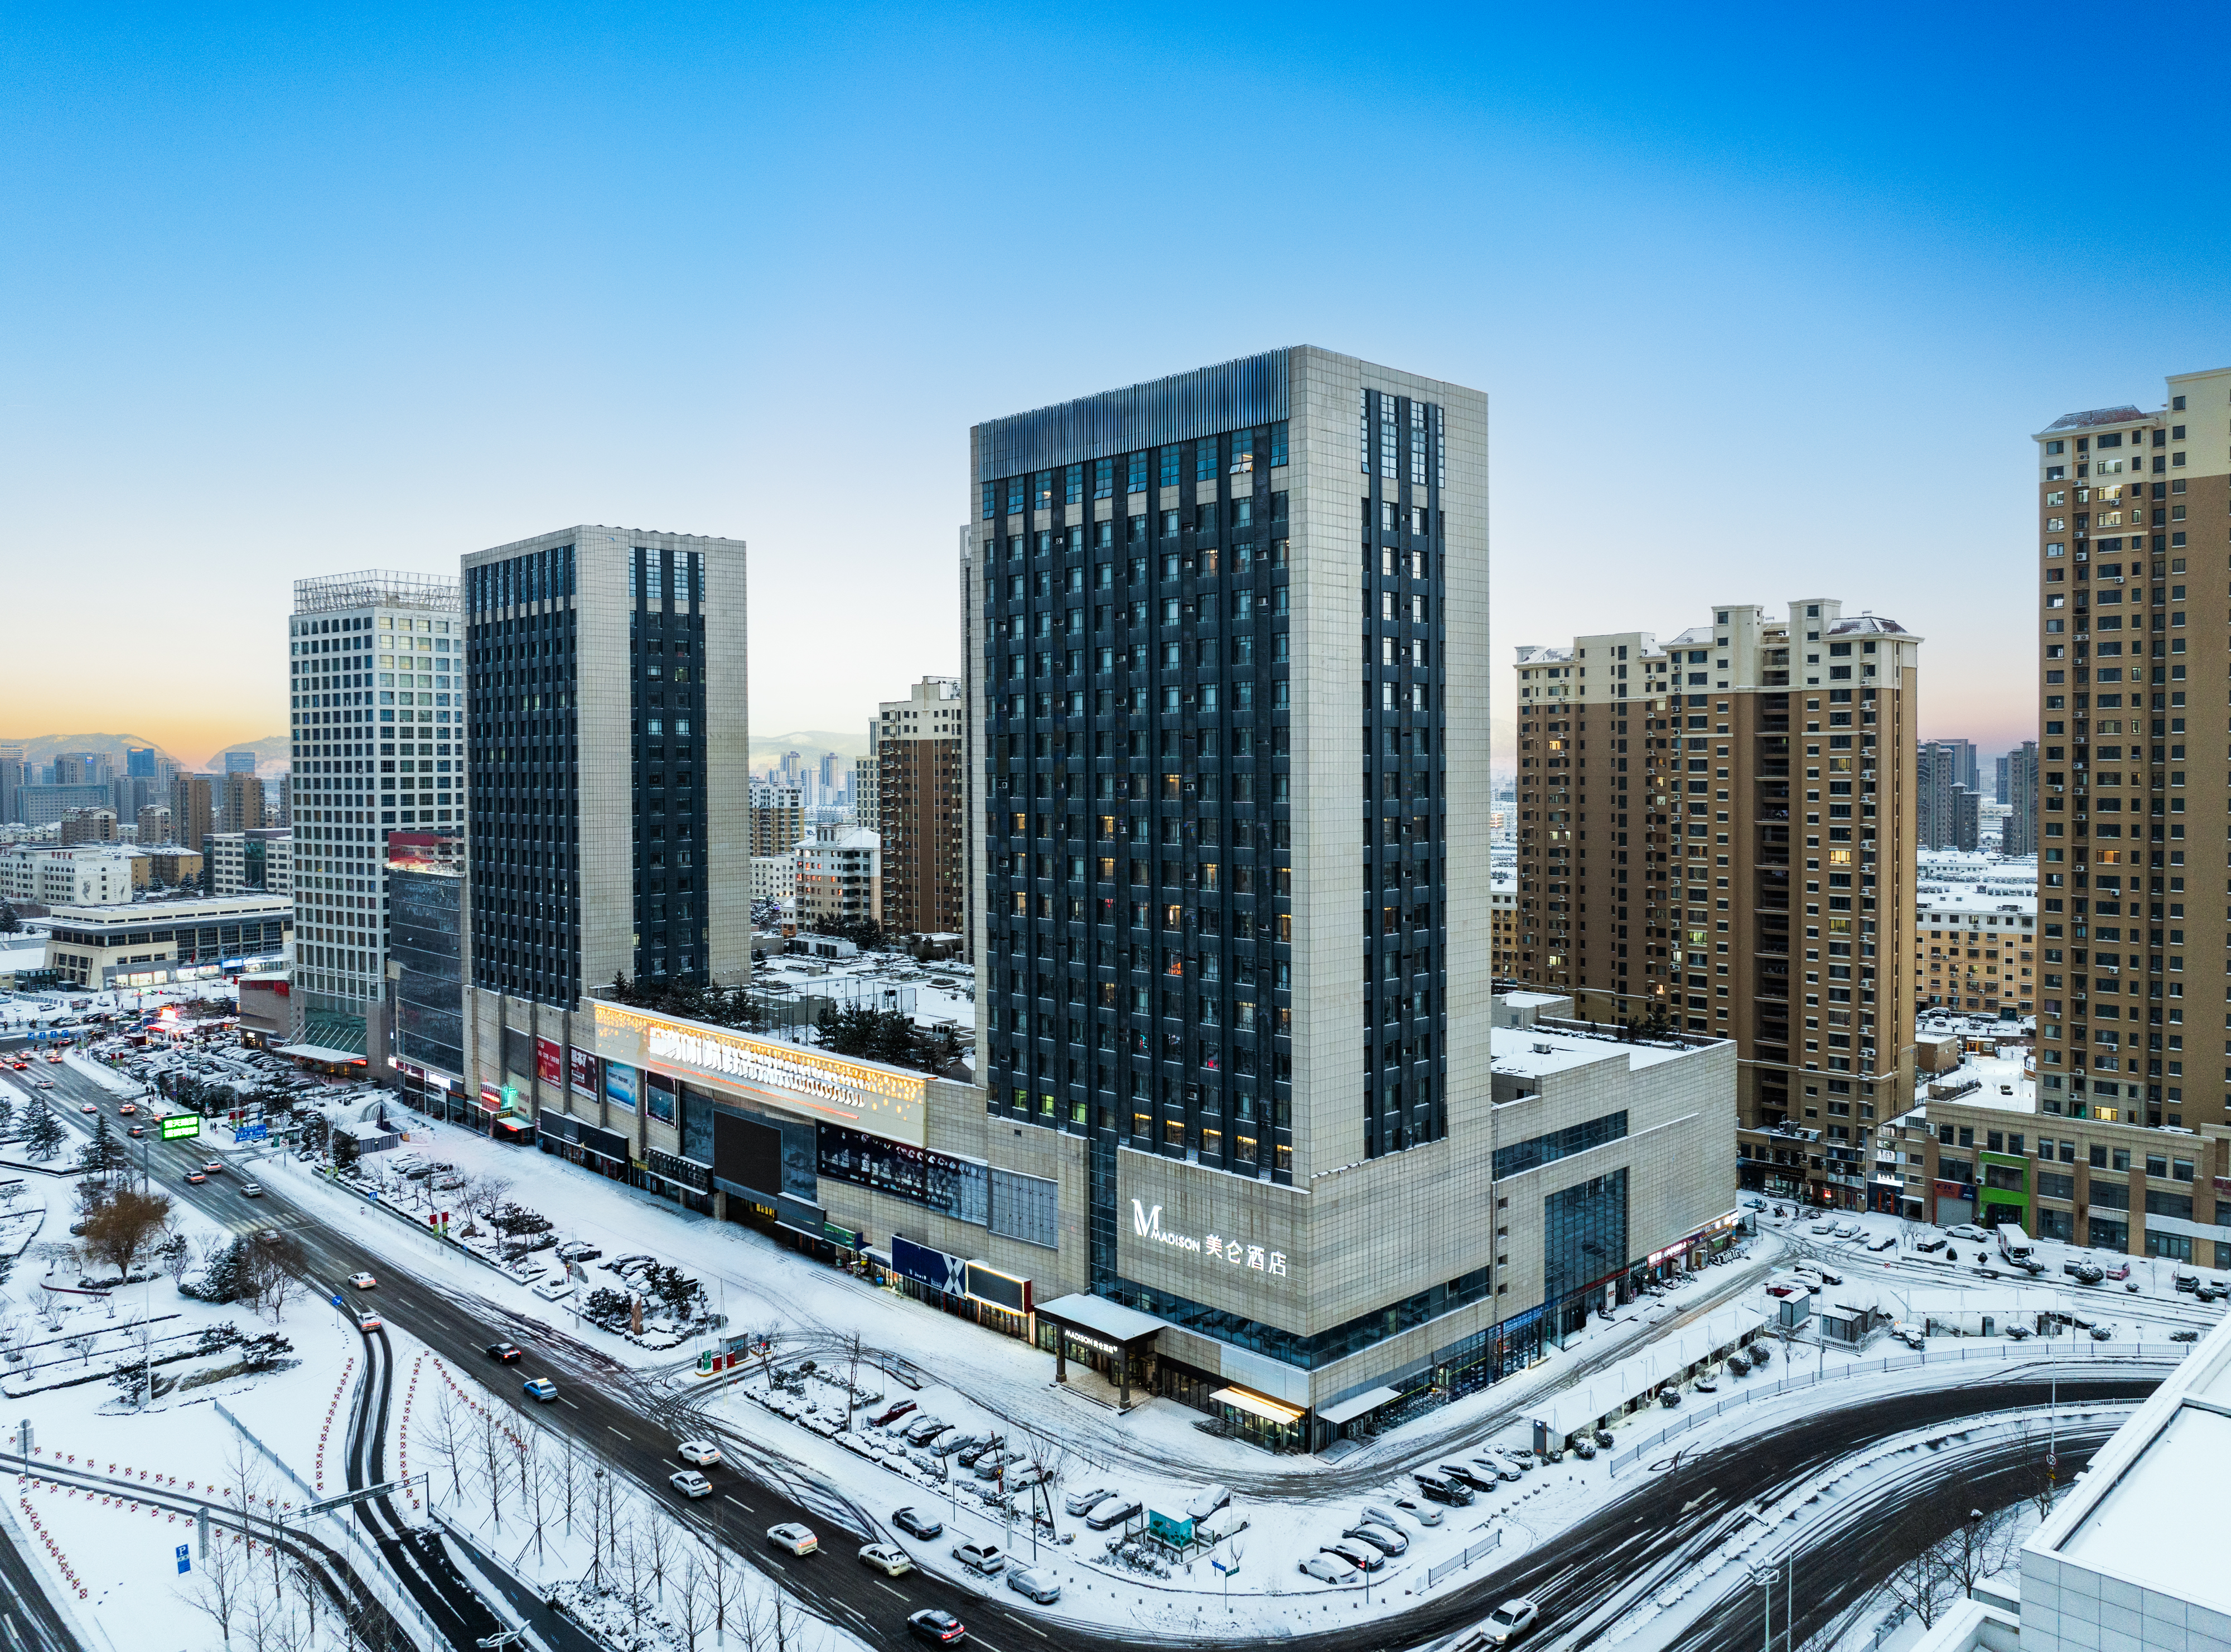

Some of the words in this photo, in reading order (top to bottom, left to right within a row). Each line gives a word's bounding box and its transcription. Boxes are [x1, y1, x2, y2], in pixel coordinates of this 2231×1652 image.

[1151, 1229, 1201, 1253] MADISON
[1205, 1233, 1287, 1278] 美仑酒店
[1064, 1329, 1093, 1346] MADISON
[178, 1546, 186, 1556] P
